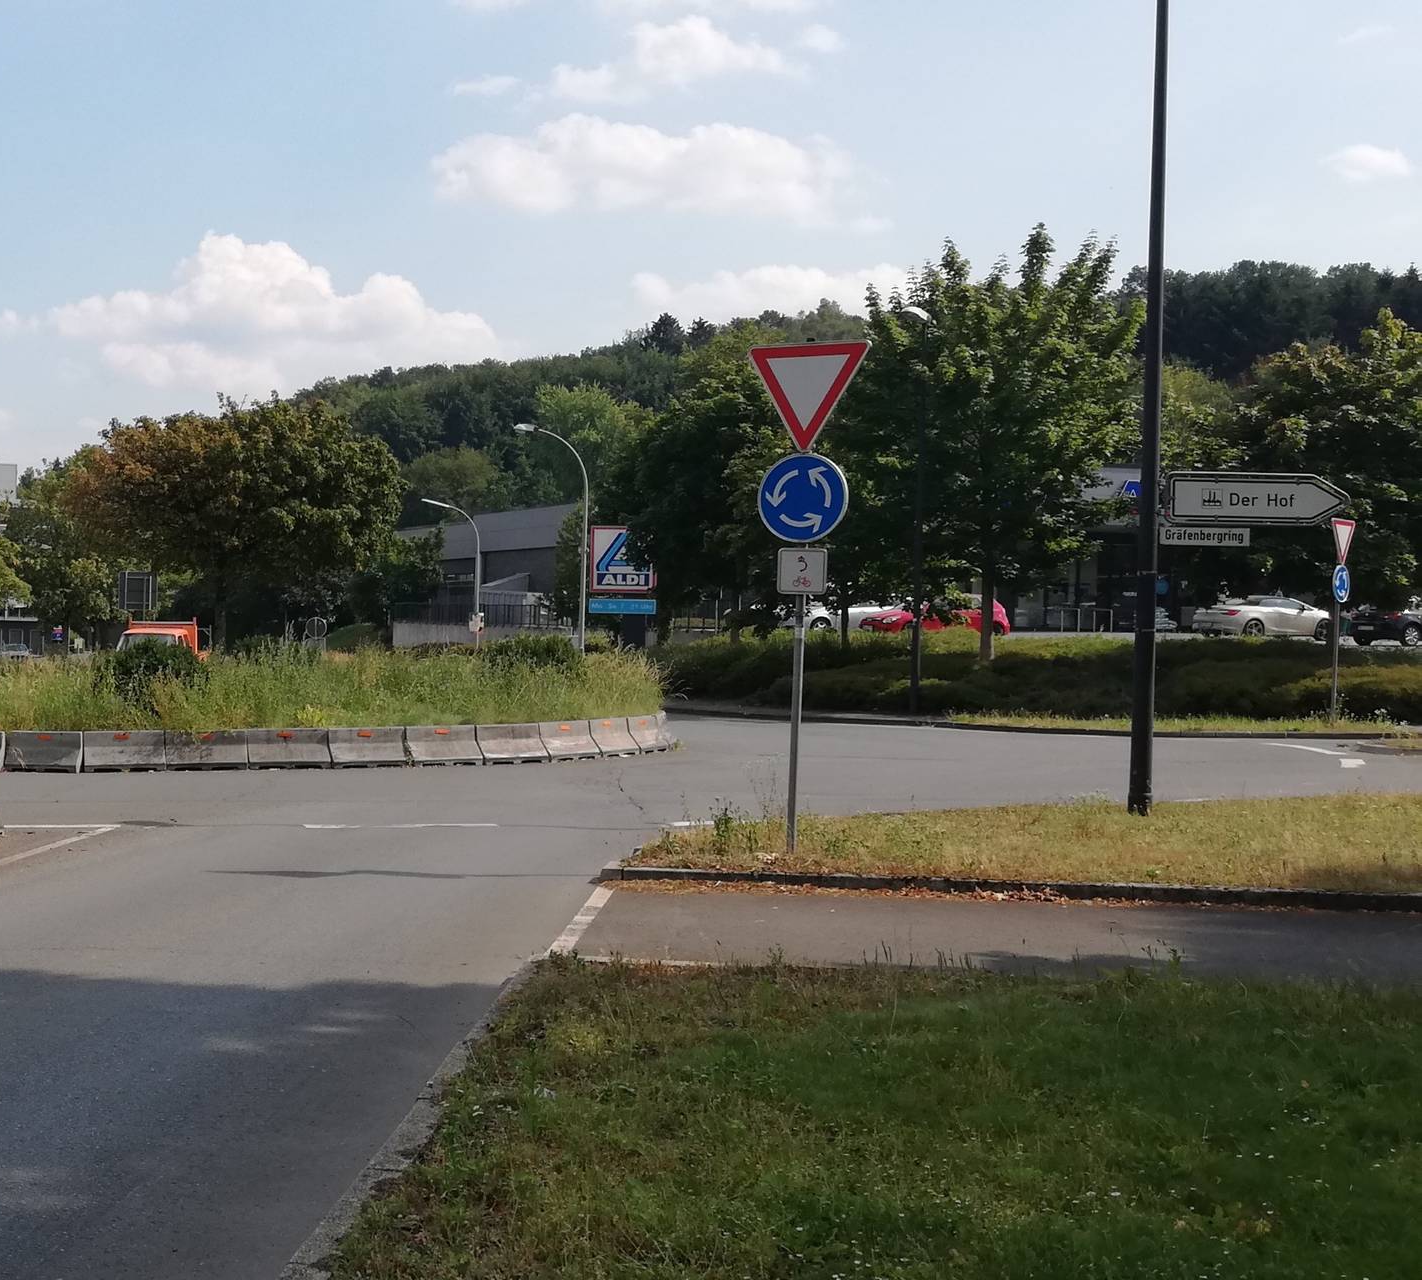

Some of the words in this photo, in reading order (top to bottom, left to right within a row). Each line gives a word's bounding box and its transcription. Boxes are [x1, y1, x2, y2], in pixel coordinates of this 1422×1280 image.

[1229, 492, 1259, 507] Der
[1266, 493, 1295, 508] Hof
[1165, 528, 1244, 544] Gräfenbergring
[601, 574, 646, 585] ALDI
